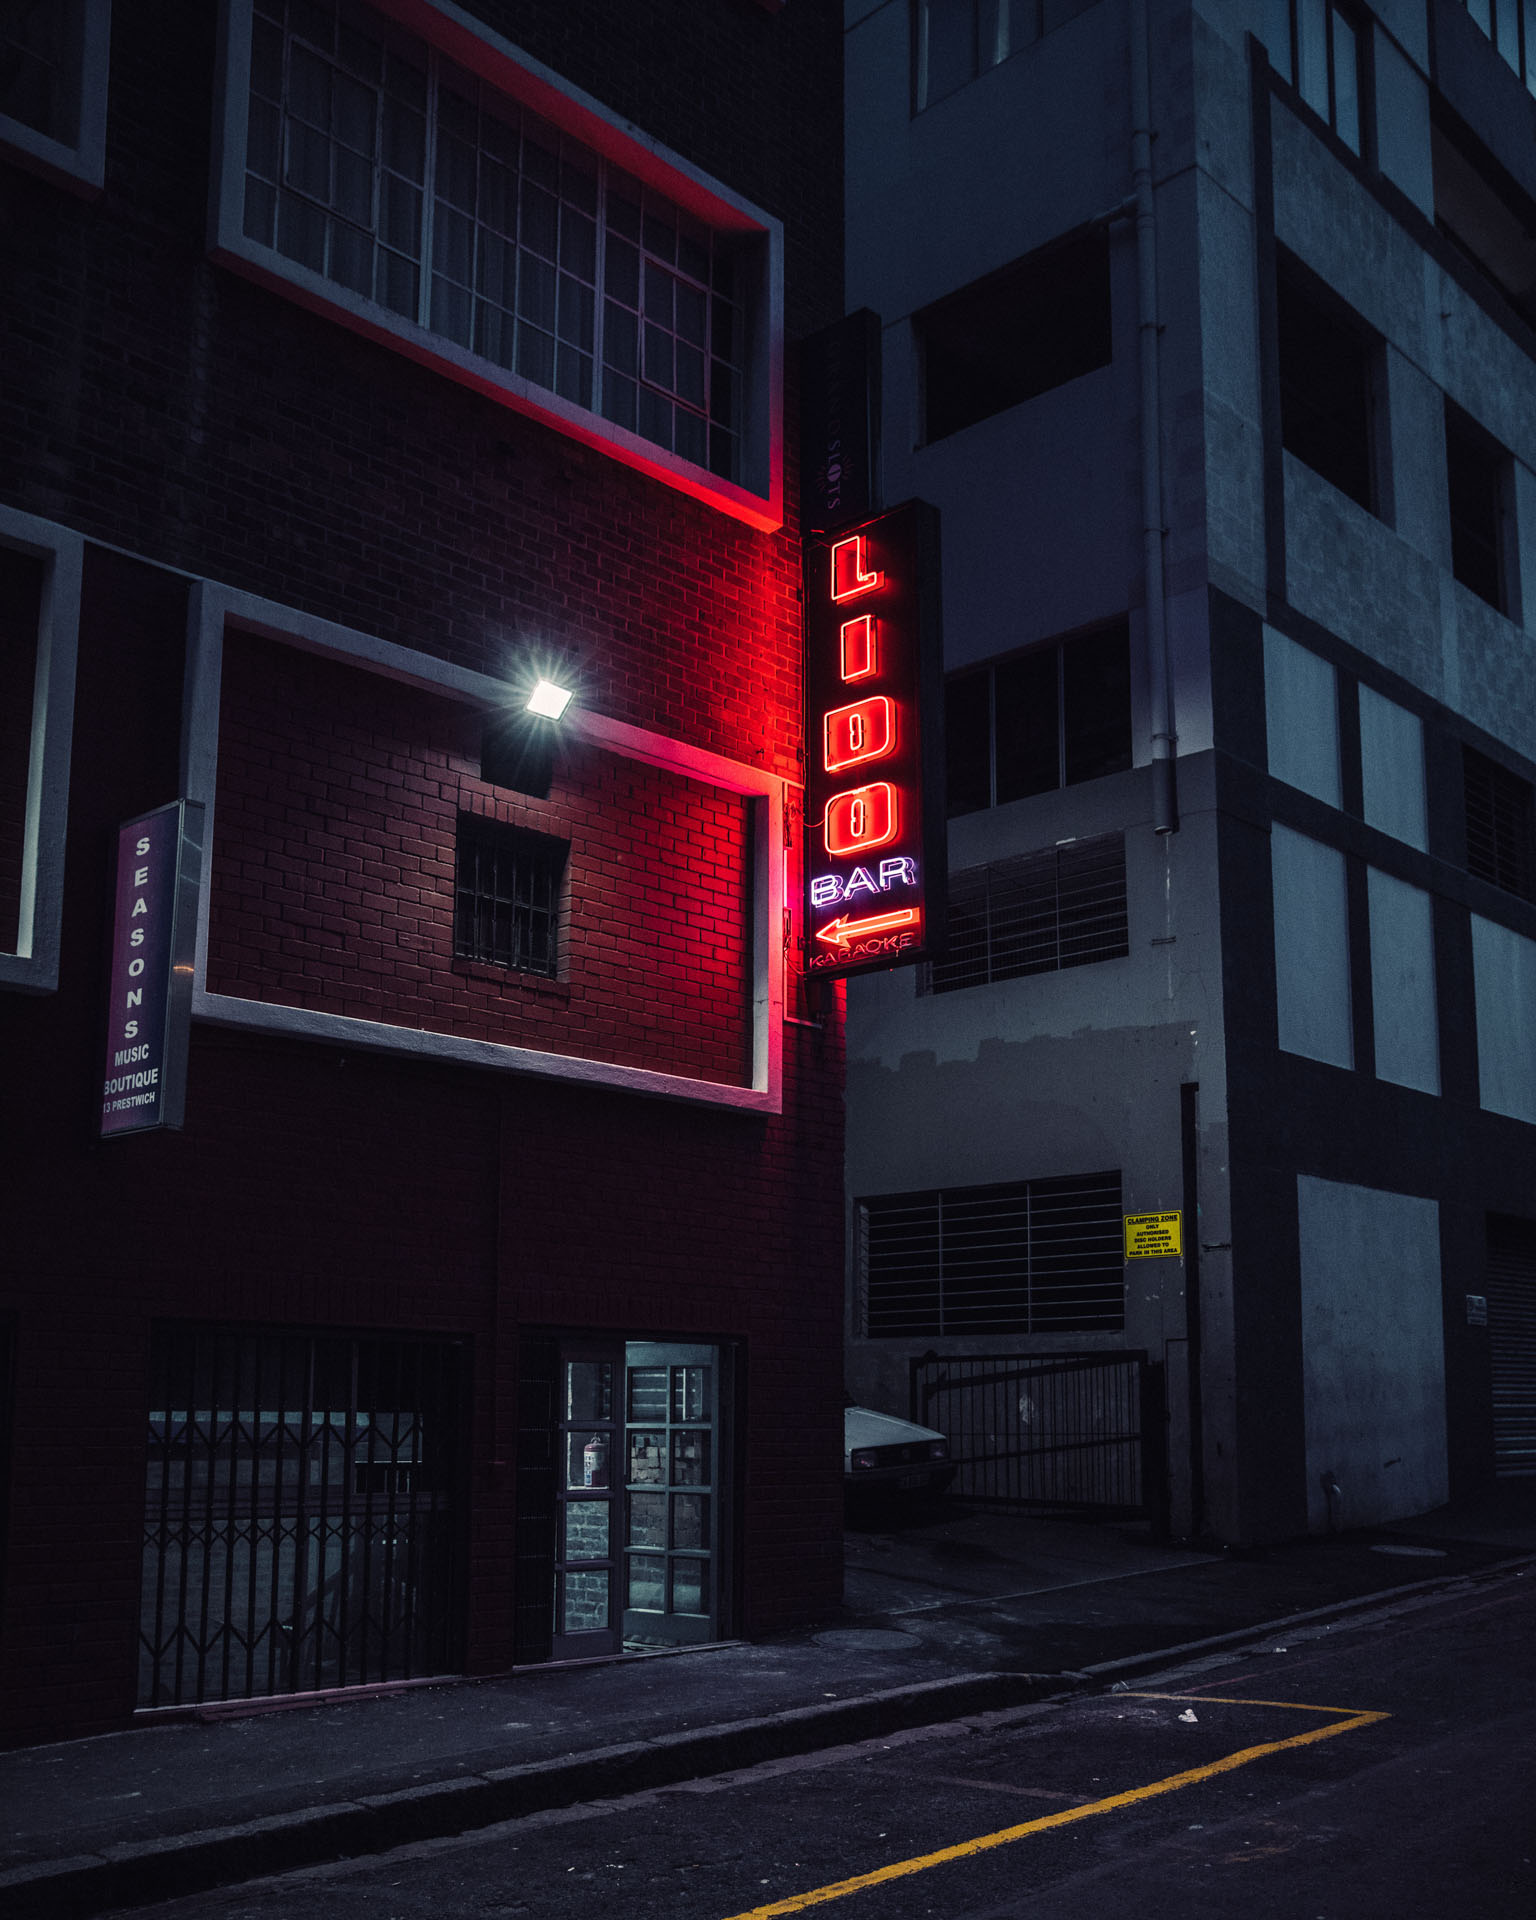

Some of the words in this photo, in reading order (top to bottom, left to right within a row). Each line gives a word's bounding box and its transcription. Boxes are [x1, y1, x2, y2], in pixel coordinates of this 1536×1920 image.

[823, 535, 897, 855] LIDO
[811, 857, 916, 908] BAR
[124, 836, 151, 1039] SEASONS
[808, 932, 915, 968] KARAOKE
[114, 1043, 150, 1067] MUSIC
[104, 1067, 159, 1096] BOUTIQUE
[112, 1091, 156, 1112] PRESTWICH
[1128, 1216, 1159, 1225] CLAMPING
